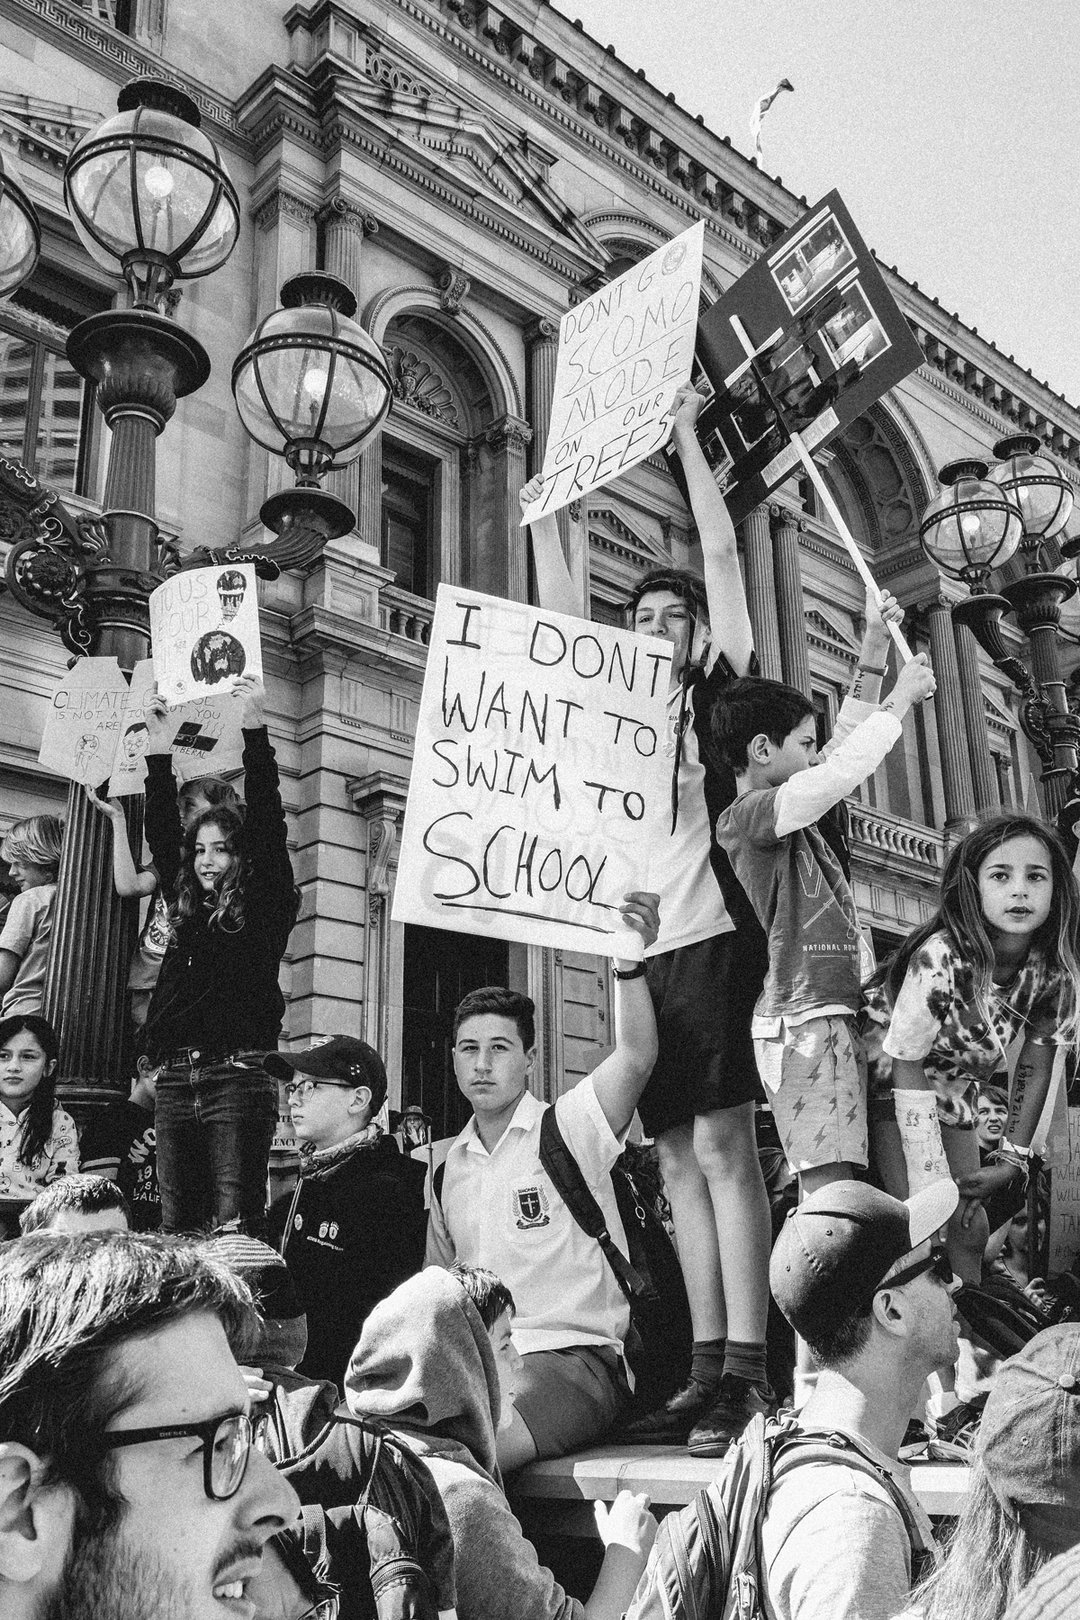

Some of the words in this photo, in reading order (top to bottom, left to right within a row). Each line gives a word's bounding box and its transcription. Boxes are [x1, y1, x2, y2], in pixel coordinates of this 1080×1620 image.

[564, 280, 627, 344] DON'T
[568, 281, 693, 393] SCOMO
[561, 335, 684, 438] MODE
[541, 410, 670, 512] TREES
[554, 435, 583, 465] ON
[622, 392, 664, 426] OUR
[179, 574, 208, 603] US
[446, 602, 481, 649] I
[530, 620, 672, 697] DONT
[53, 690, 136, 710] CLIMATE
[55, 711, 66, 720] IS
[73, 710, 102, 720] NOT
[195, 707, 221, 719] YOU
[96, 721, 120, 731] ARE
[442, 656, 584, 745] WANT
[604, 711, 657, 757] TO
[432, 739, 561, 811] SWIM
[583, 781, 645, 820] TO
[423, 811, 619, 911] SCHOOL
[802, 943, 841, 952] NATIONAL
